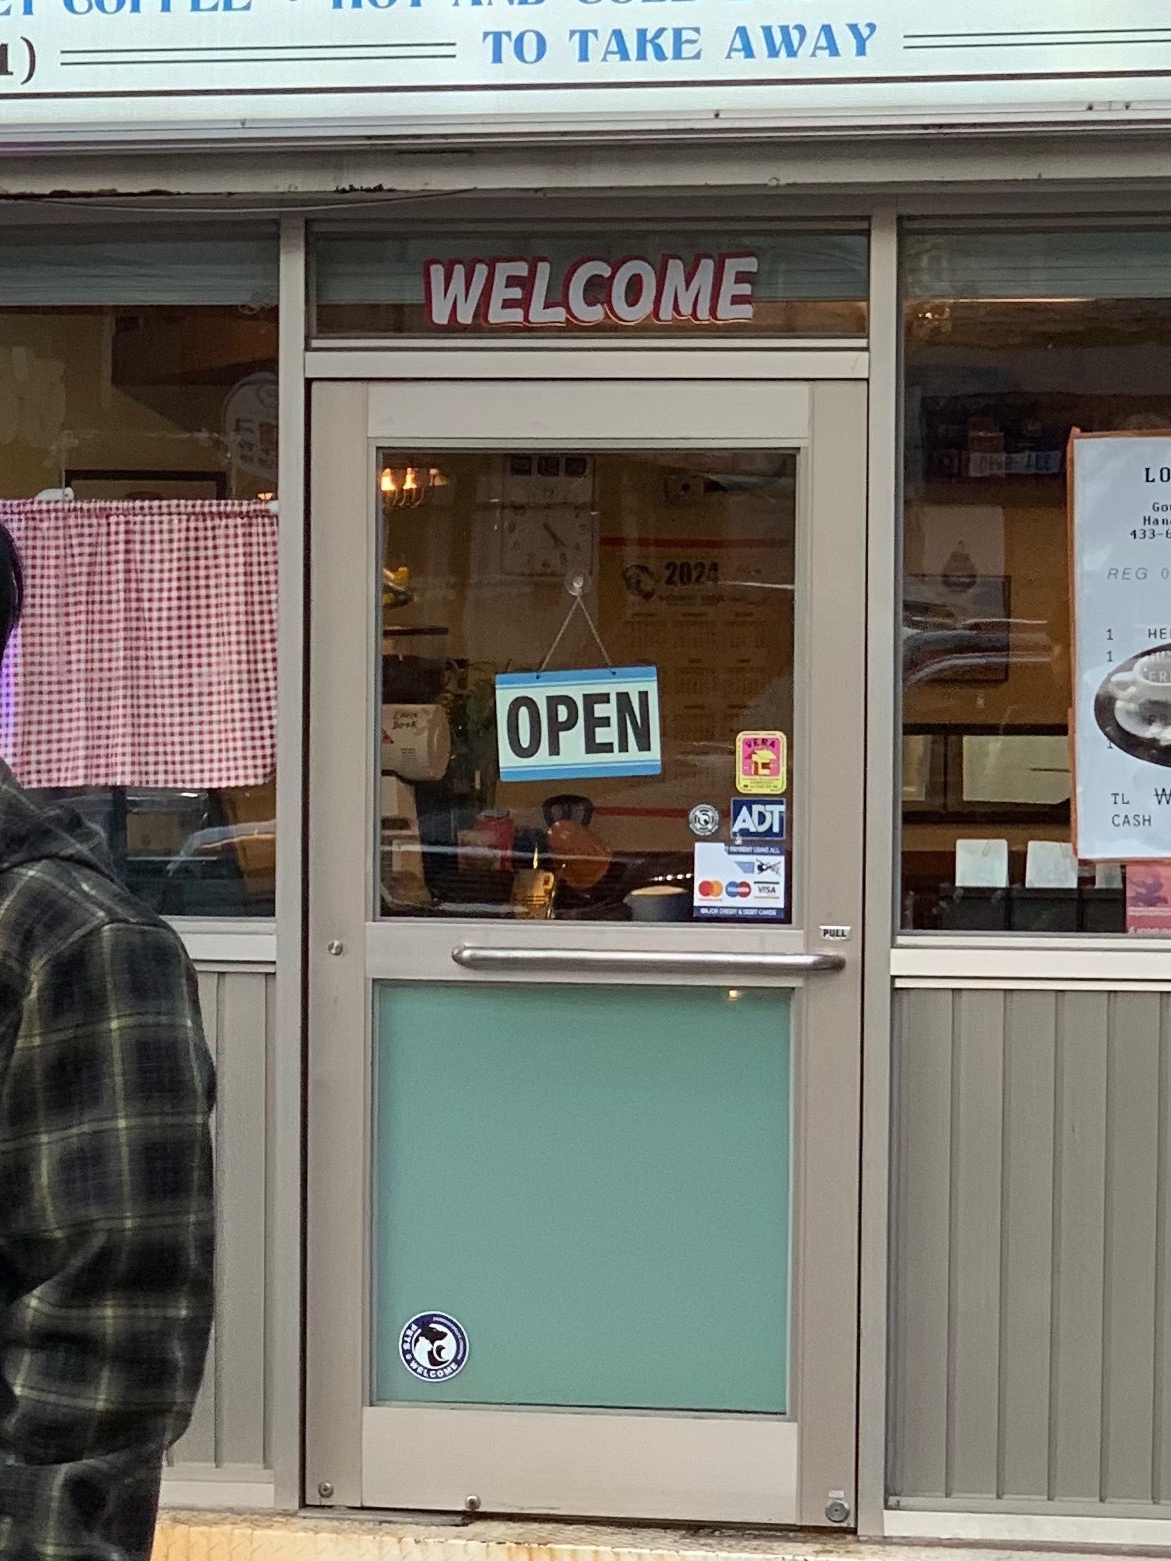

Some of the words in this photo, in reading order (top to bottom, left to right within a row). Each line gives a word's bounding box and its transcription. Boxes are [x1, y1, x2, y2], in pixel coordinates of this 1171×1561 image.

[482, 28, 547, 65] TO
[568, 26, 702, 63] TAKE
[725, 22, 878, 59] AWAY
[425, 254, 758, 327] WELCOME
[1152, 501, 1171, 512] Go
[1142, 515, 1171, 526] Han
[1107, 566, 1148, 580] REG
[1147, 627, 1171, 640] HE
[507, 690, 652, 759] OPEN
[732, 804, 786, 833] ADT
[1111, 813, 1152, 827] CASH
[822, 929, 847, 938] PULL
[409, 1360, 458, 1378] WELCOME
